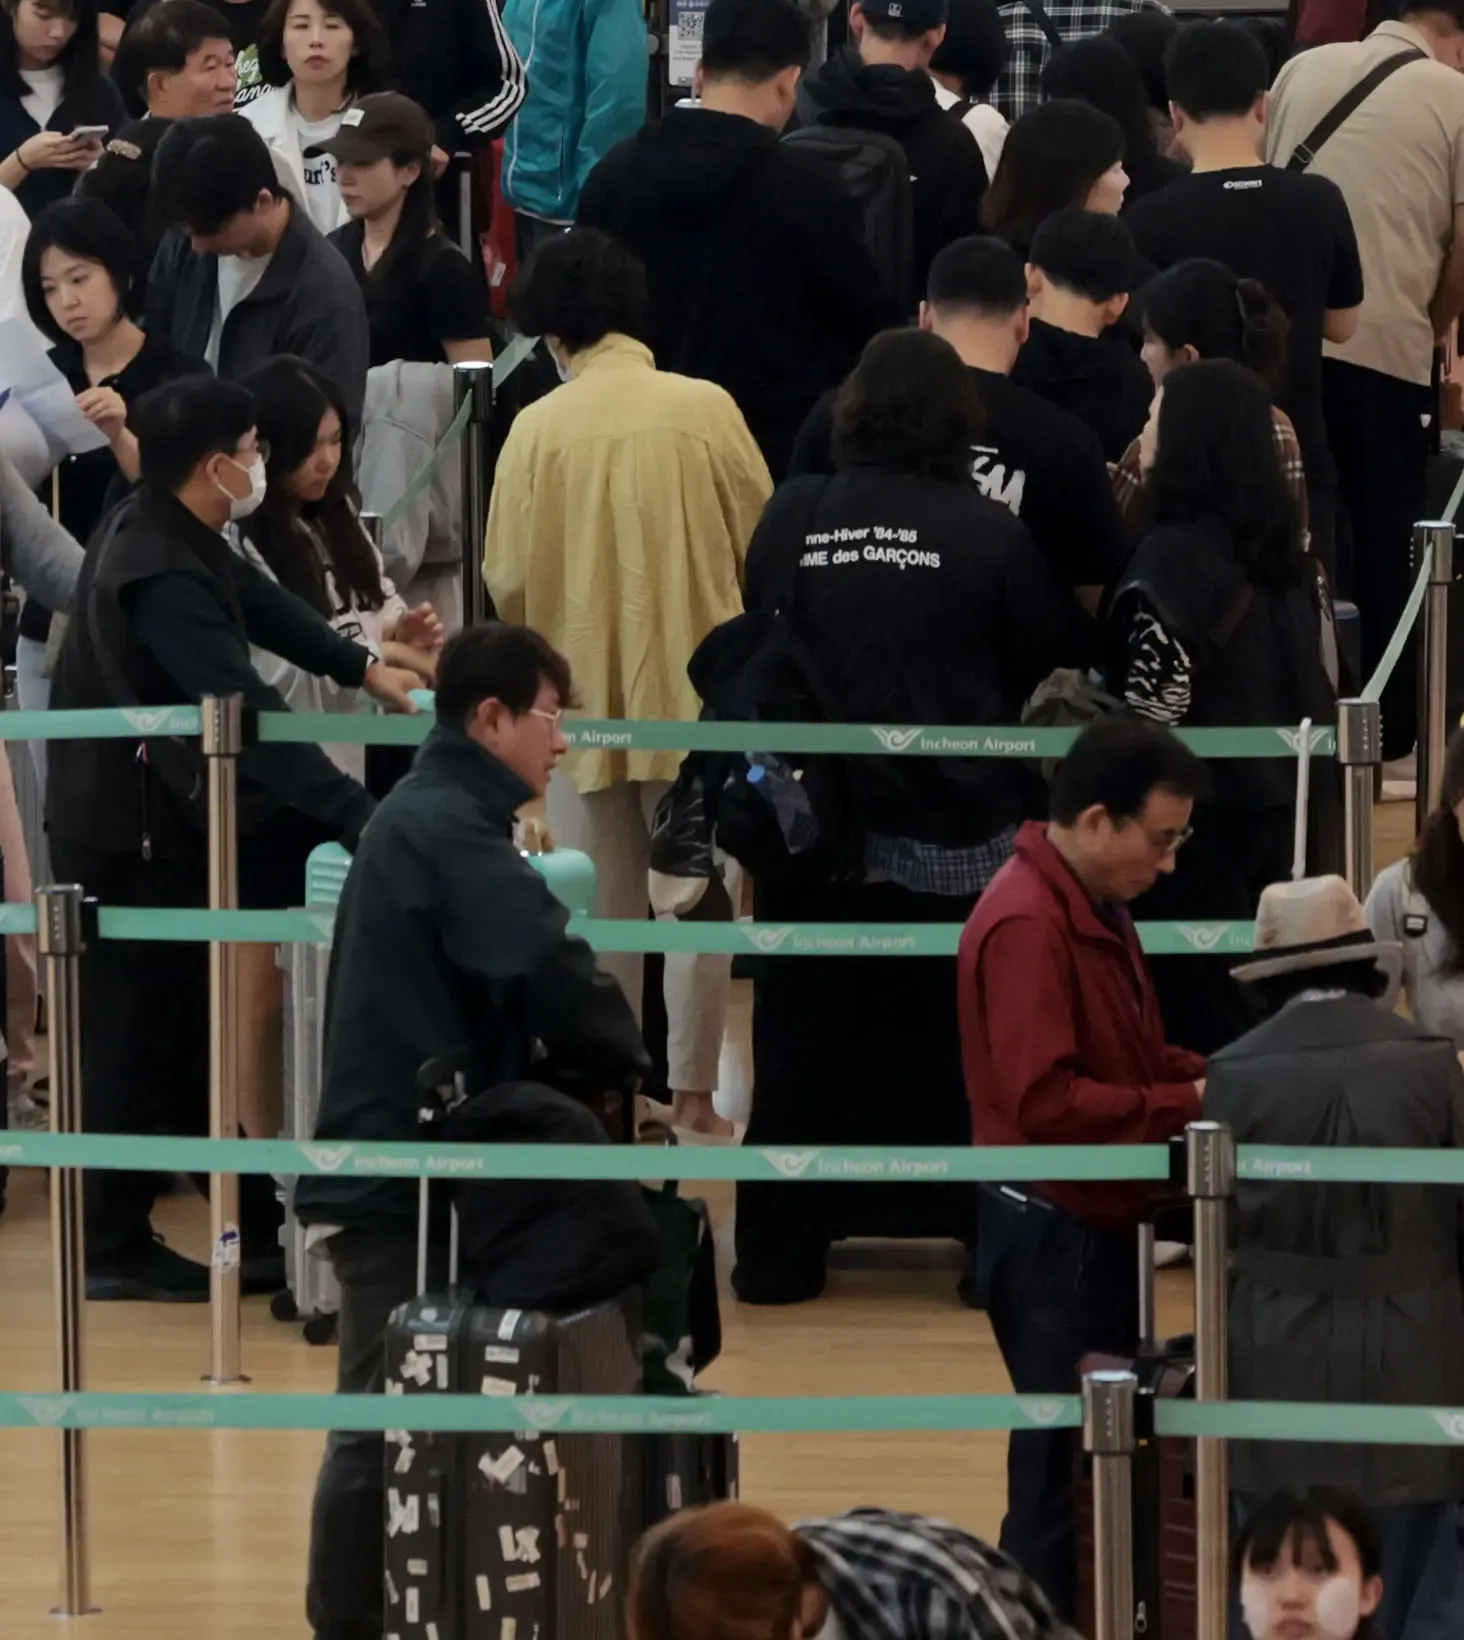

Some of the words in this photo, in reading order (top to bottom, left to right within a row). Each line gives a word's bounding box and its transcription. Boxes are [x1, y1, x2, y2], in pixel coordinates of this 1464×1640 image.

[832, 549, 860, 565] des
[863, 545, 941, 571] GARÇONS
[580, 730, 632, 746] Airport
[920, 738, 979, 751] Incheon
[982, 738, 1035, 753] Airport
[793, 935, 855, 949] Incheon
[859, 935, 915, 951] Airport
[354, 1155, 418, 1170] Incheon
[426, 1156, 484, 1172] Airport
[818, 1160, 883, 1175] Incheon
[889, 1160, 949, 1176] Airport
[1253, 1161, 1312, 1175] Airport
